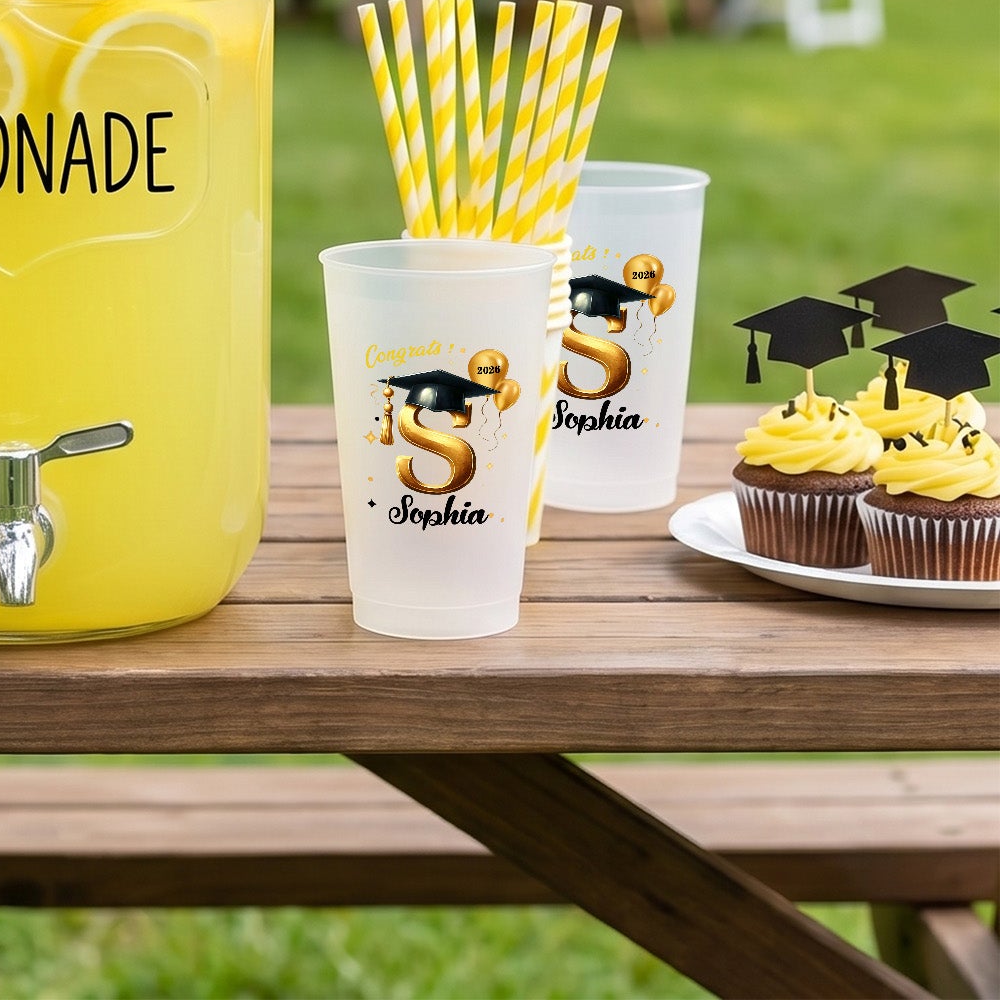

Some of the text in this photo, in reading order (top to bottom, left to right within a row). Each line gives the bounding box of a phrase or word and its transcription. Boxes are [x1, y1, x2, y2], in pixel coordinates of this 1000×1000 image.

[631, 270, 656, 280] 2026
[476, 365, 501, 375] 2026
[552, 400, 645, 436] Sophia
[395, 401, 477, 495] S
[388, 494, 489, 531] Sophia
